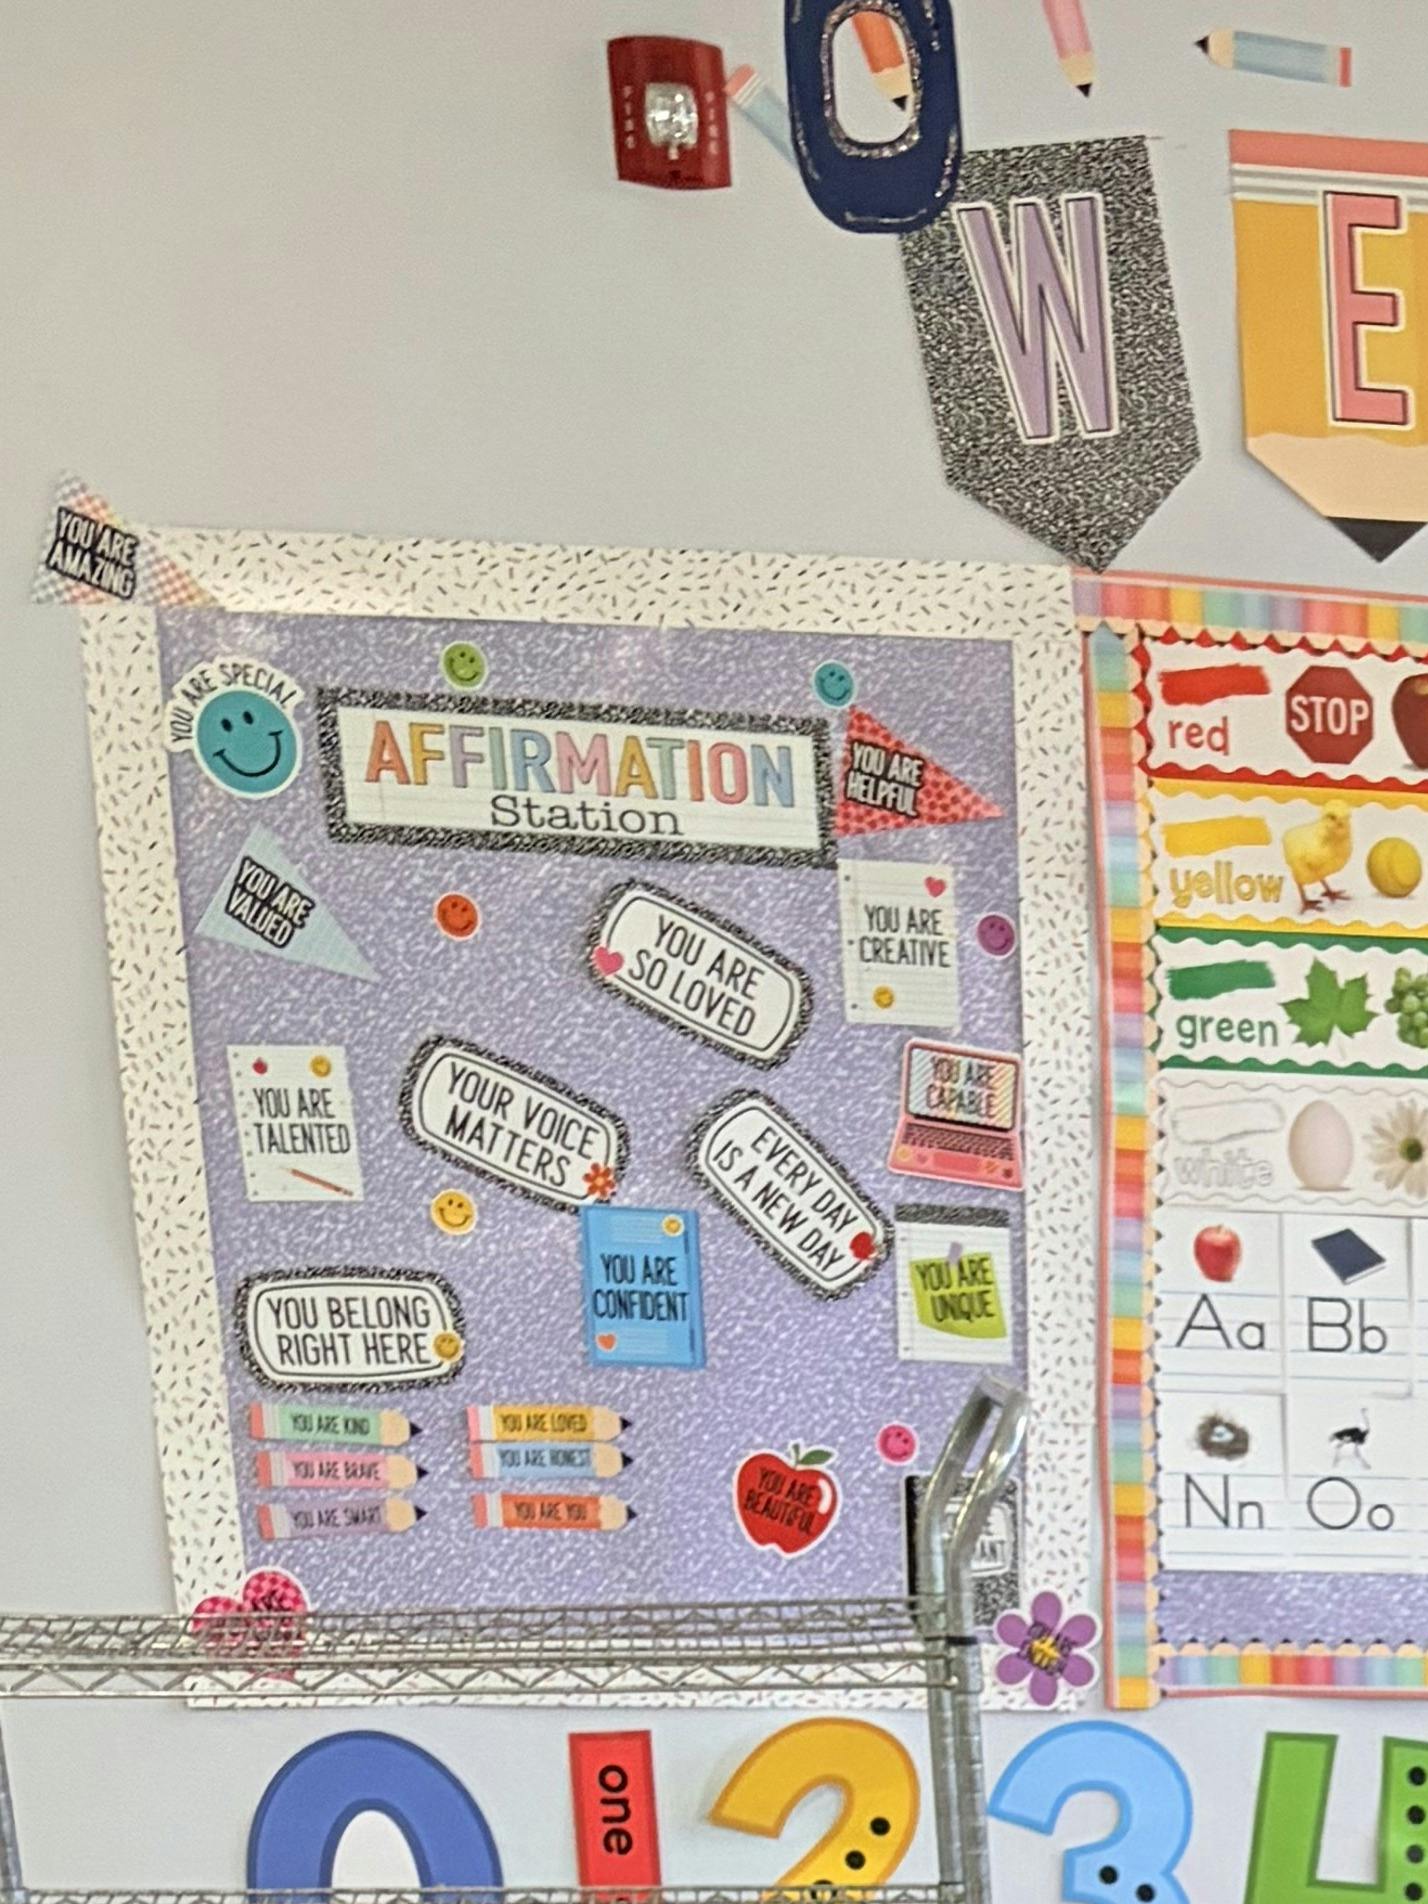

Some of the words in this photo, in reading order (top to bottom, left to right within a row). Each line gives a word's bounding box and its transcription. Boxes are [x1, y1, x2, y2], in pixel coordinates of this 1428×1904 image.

[58, 510, 95, 549] YOU
[99, 525, 139, 565] ARE
[50, 541, 135, 597] AMAZING
[181, 669, 218, 701] ARE
[218, 662, 297, 706] SPECIAL
[172, 710, 195, 743] YOU
[1167, 715, 1229, 756] red
[1291, 696, 1370, 736] STOP
[365, 720, 795, 808] AFFIRMATION
[853, 742, 886, 776] YOU
[887, 754, 924, 786] ARE
[490, 794, 684, 836] Station
[847, 772, 918, 816] HELPFUL
[238, 859, 277, 900] YOU
[272, 885, 313, 924] ARE
[1169, 860, 1284, 908] yellow
[228, 887, 293, 946] VALUED
[863, 905, 901, 935] YOU
[906, 908, 943, 937] ARE
[655, 915, 706, 966] YOU
[706, 949, 765, 1000] ARE
[859, 936, 951, 968] CREATIVE
[628, 949, 668, 991] SO
[669, 970, 756, 1037] LOVED
[1176, 1012, 1279, 1050] green
[253, 1087, 292, 1119] YOU
[299, 1087, 337, 1119] ARE
[447, 1061, 515, 1121] YOUR
[524, 1096, 602, 1160] VOICE
[254, 1122, 351, 1155] TALENTED
[445, 1105, 571, 1188] MATTERS
[750, 1125, 823, 1196] EVERY
[811, 1180, 860, 1234] DAY
[1173, 1147, 1277, 1190] white
[712, 1139, 743, 1172] IS
[734, 1164, 760, 1194] A
[753, 1180, 808, 1235] NEW
[798, 1223, 846, 1273] DAY
[600, 1254, 637, 1287] YOU
[641, 1255, 679, 1289] ARE
[916, 1262, 953, 1290] YOU
[956, 1258, 996, 1289] ARE
[266, 1298, 319, 1330] YOU
[328, 1296, 431, 1330] BELONG
[592, 1288, 690, 1323] CONFIDENT
[930, 1289, 996, 1325] UNIQUE
[1176, 1293, 1266, 1351] Aa
[1307, 1296, 1388, 1354] Bb
[278, 1334, 354, 1366] RIGHT
[363, 1333, 431, 1366] HERE
[1184, 1473, 1264, 1529] Nn
[1308, 1477, 1394, 1531] Oo
[598, 1763, 633, 1858] one
